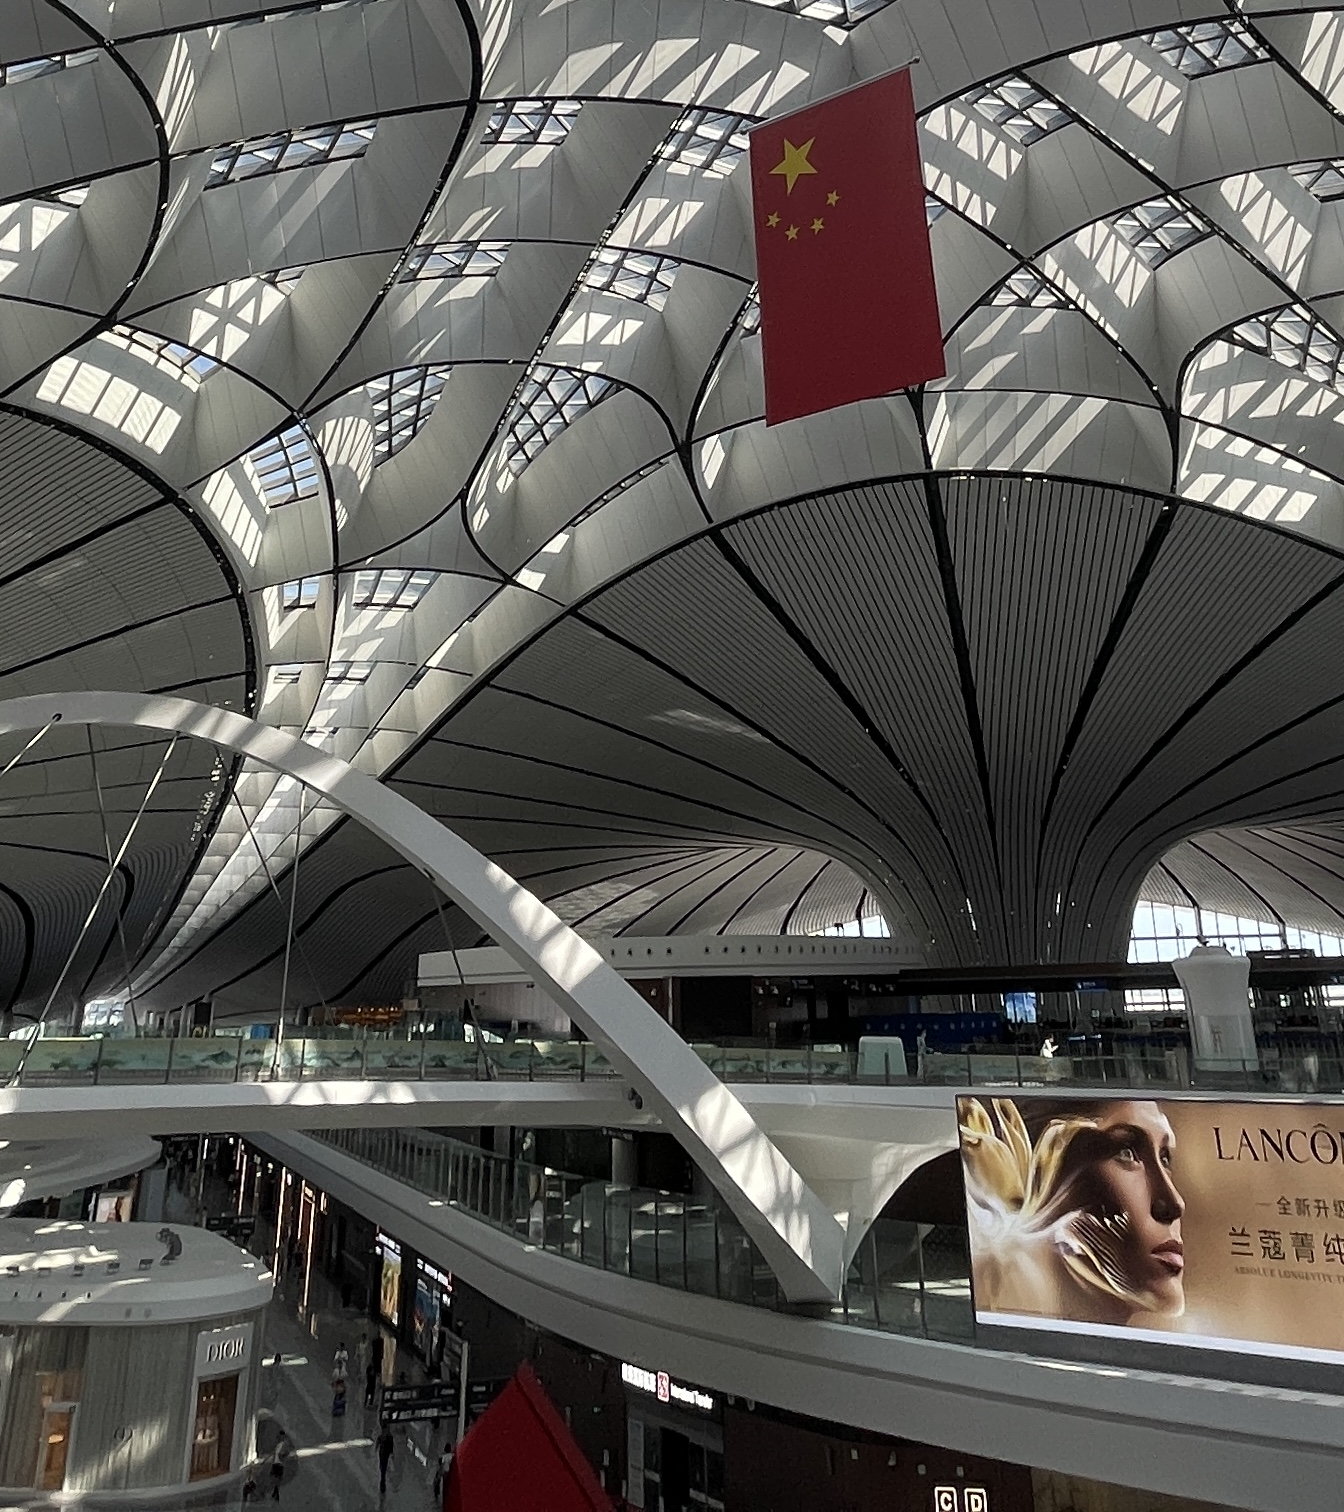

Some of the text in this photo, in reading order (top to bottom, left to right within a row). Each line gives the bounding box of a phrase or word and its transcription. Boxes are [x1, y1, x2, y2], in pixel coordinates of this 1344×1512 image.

[206, 1336, 244, 1362] DIOR
[940, 1492, 953, 1511] C
[970, 1494, 983, 1512] D
